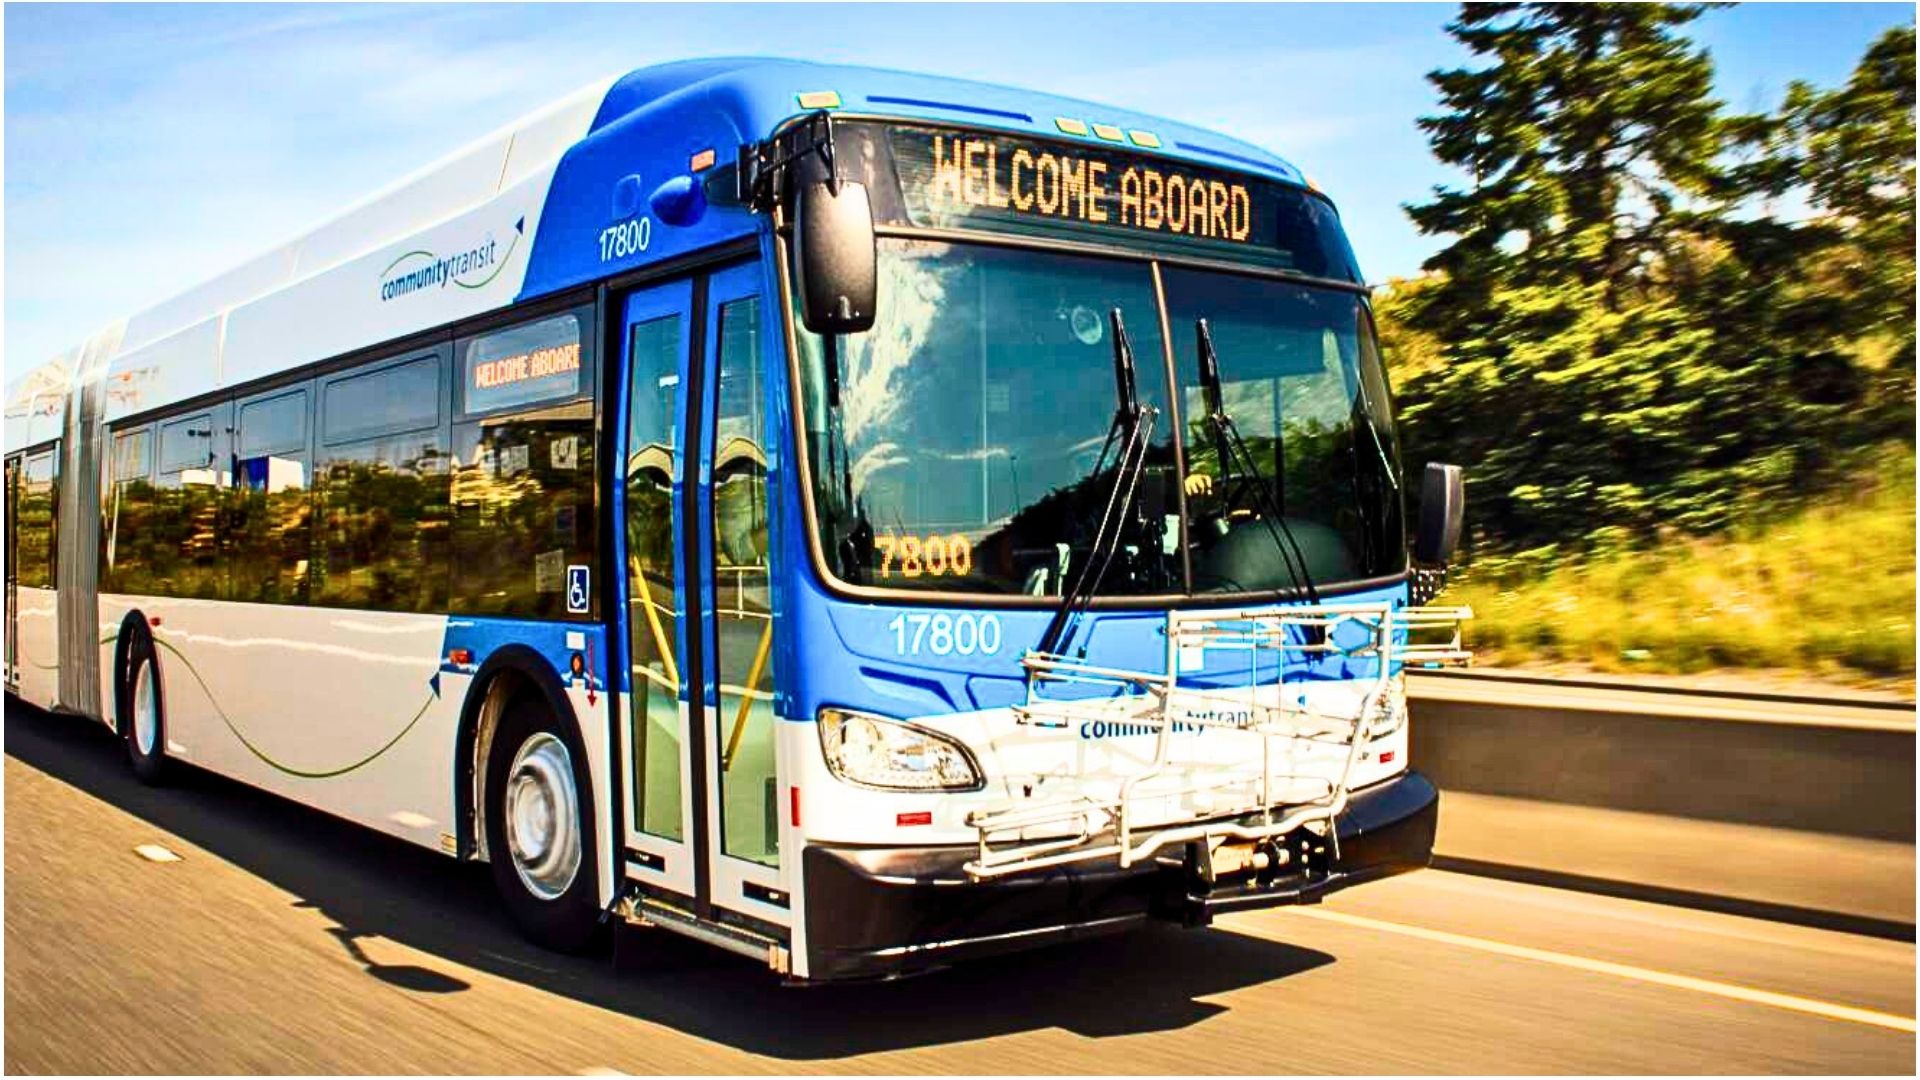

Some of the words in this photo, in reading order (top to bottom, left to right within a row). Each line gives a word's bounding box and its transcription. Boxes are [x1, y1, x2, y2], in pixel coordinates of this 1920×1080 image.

[933, 135, 1108, 222] WELCOME
[1120, 166, 1250, 242] ABOARD
[598, 216, 650, 263] 17800
[475, 355, 528, 389] WELCOME
[888, 611, 1001, 656] 17800
